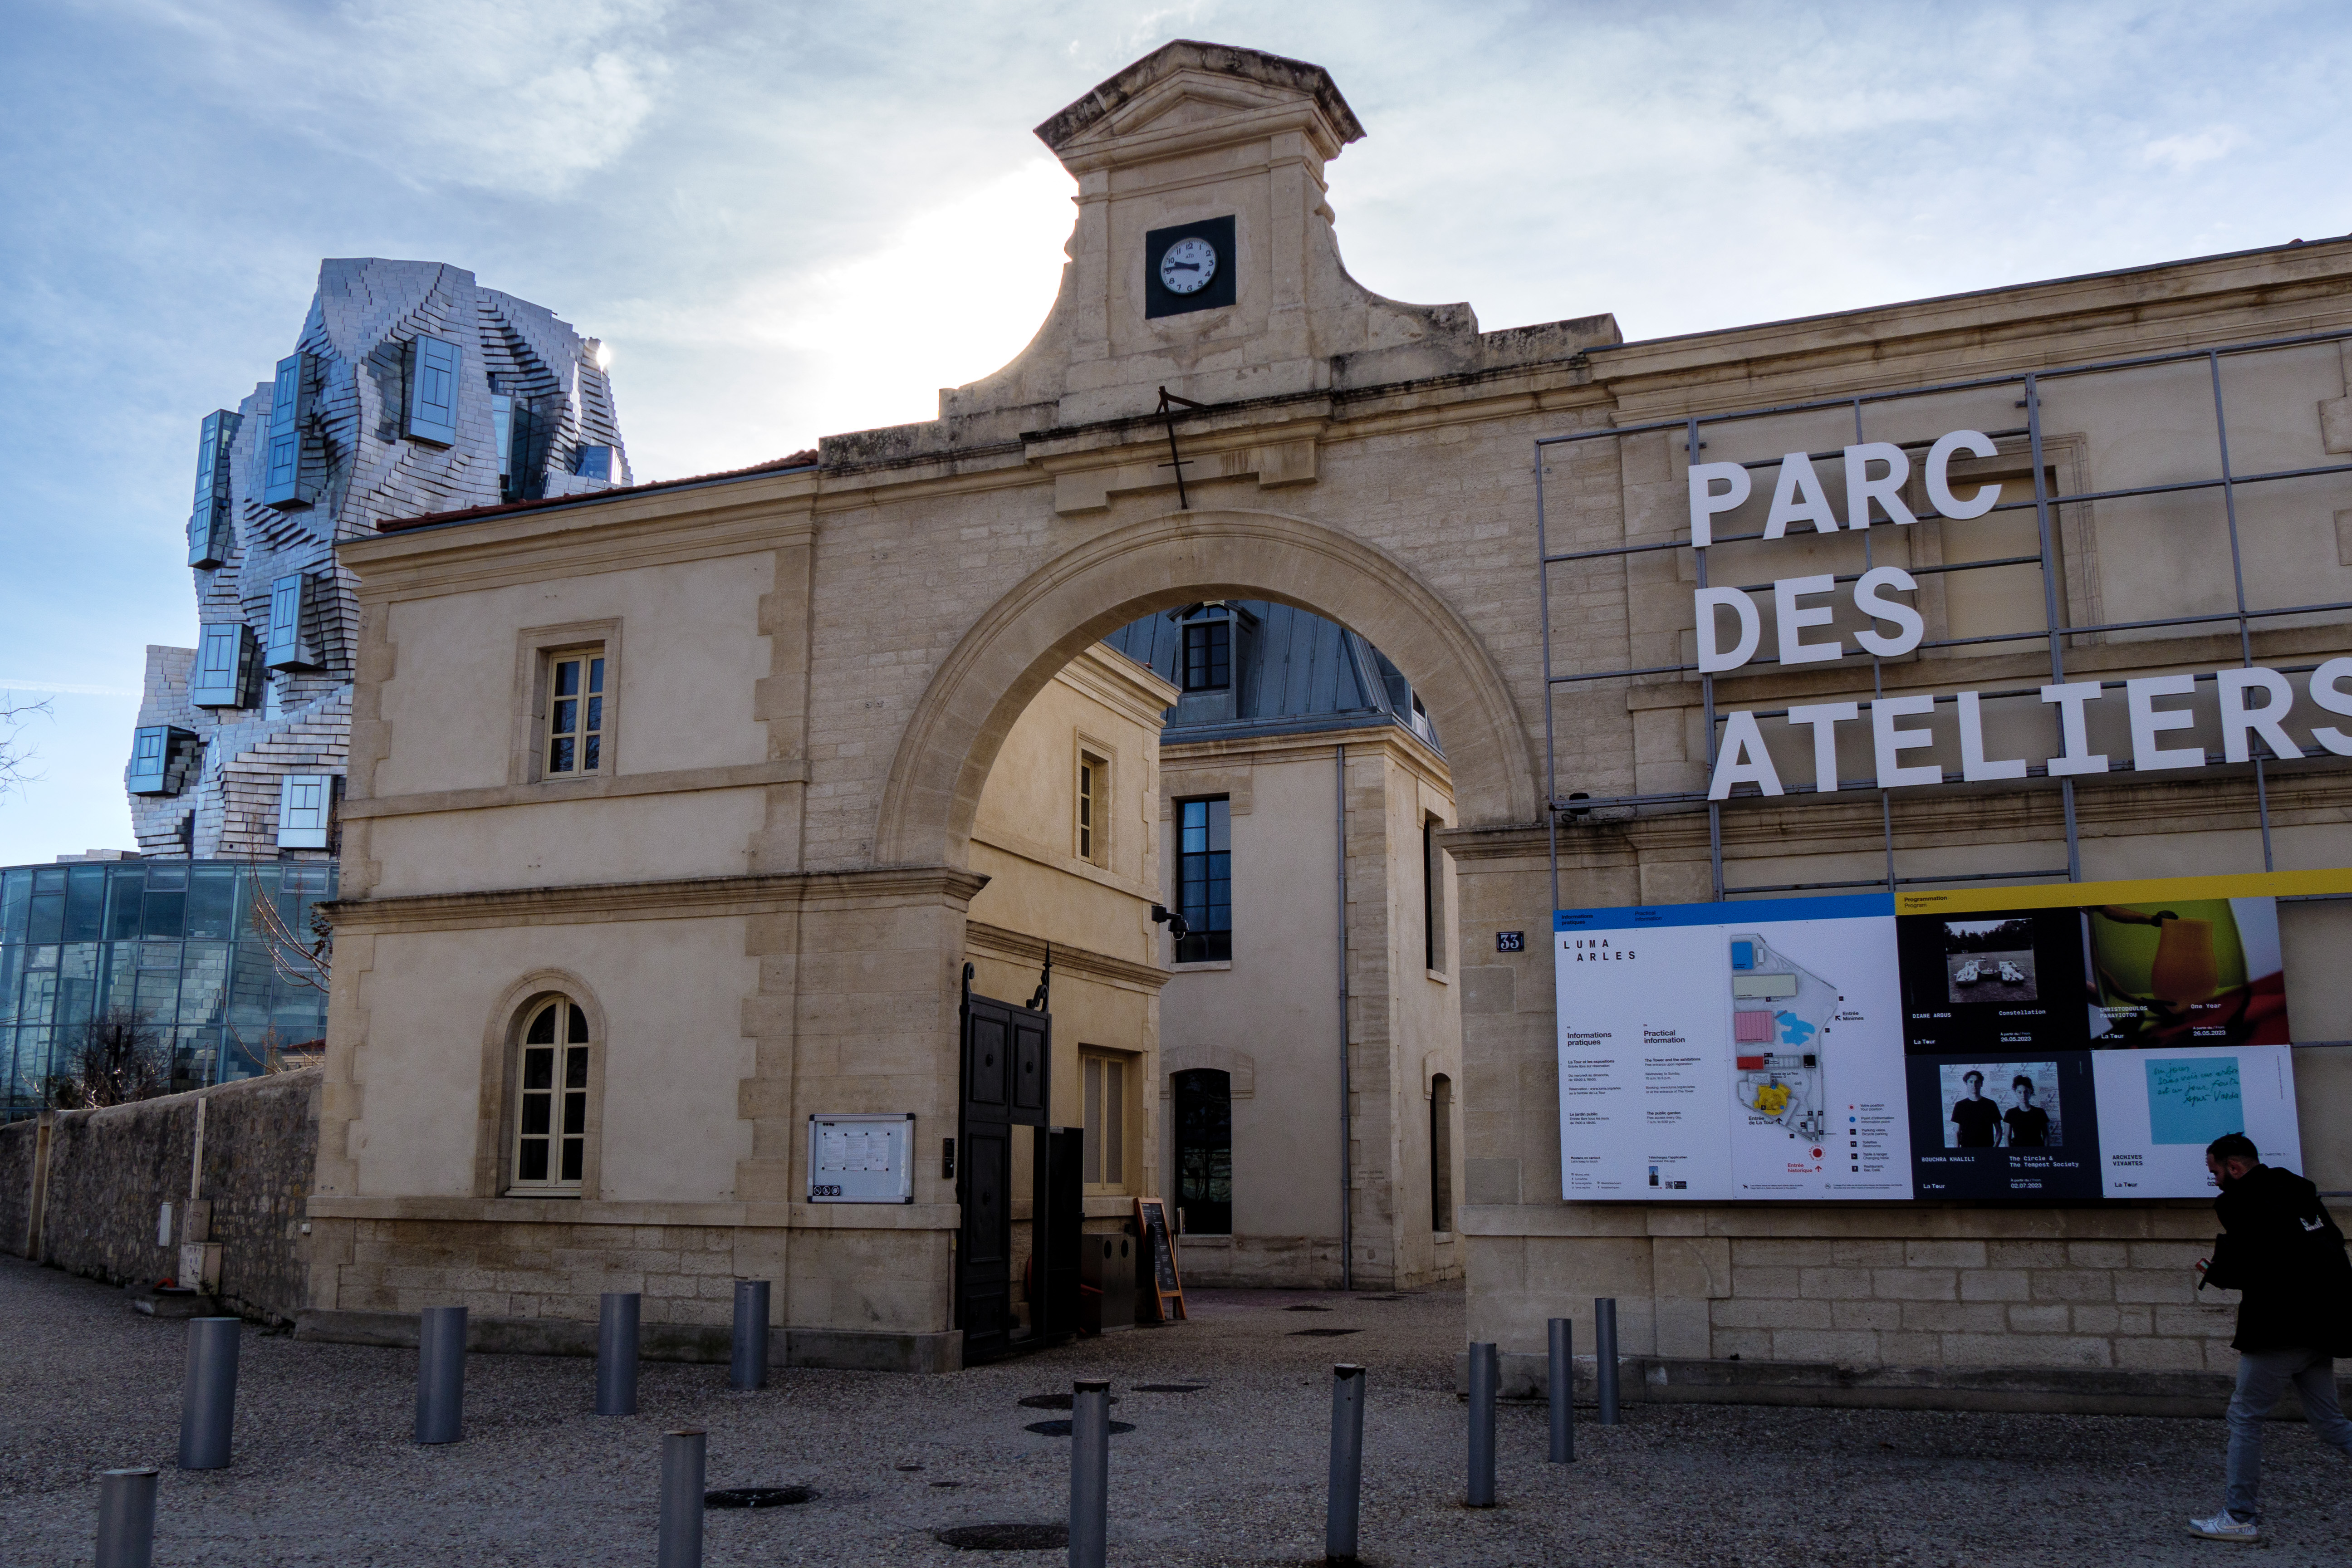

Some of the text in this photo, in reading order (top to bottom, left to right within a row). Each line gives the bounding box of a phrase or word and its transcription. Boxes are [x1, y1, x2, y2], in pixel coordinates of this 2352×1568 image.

[1688, 430, 2002, 549] PARC
[1695, 566, 1924, 674] DES
[1707, 657, 2352, 802] ATELIERS
[1501, 935, 1519, 949] 33
[1564, 939, 1609, 949] LUMA
[1577, 951, 1635, 961] ARLES
